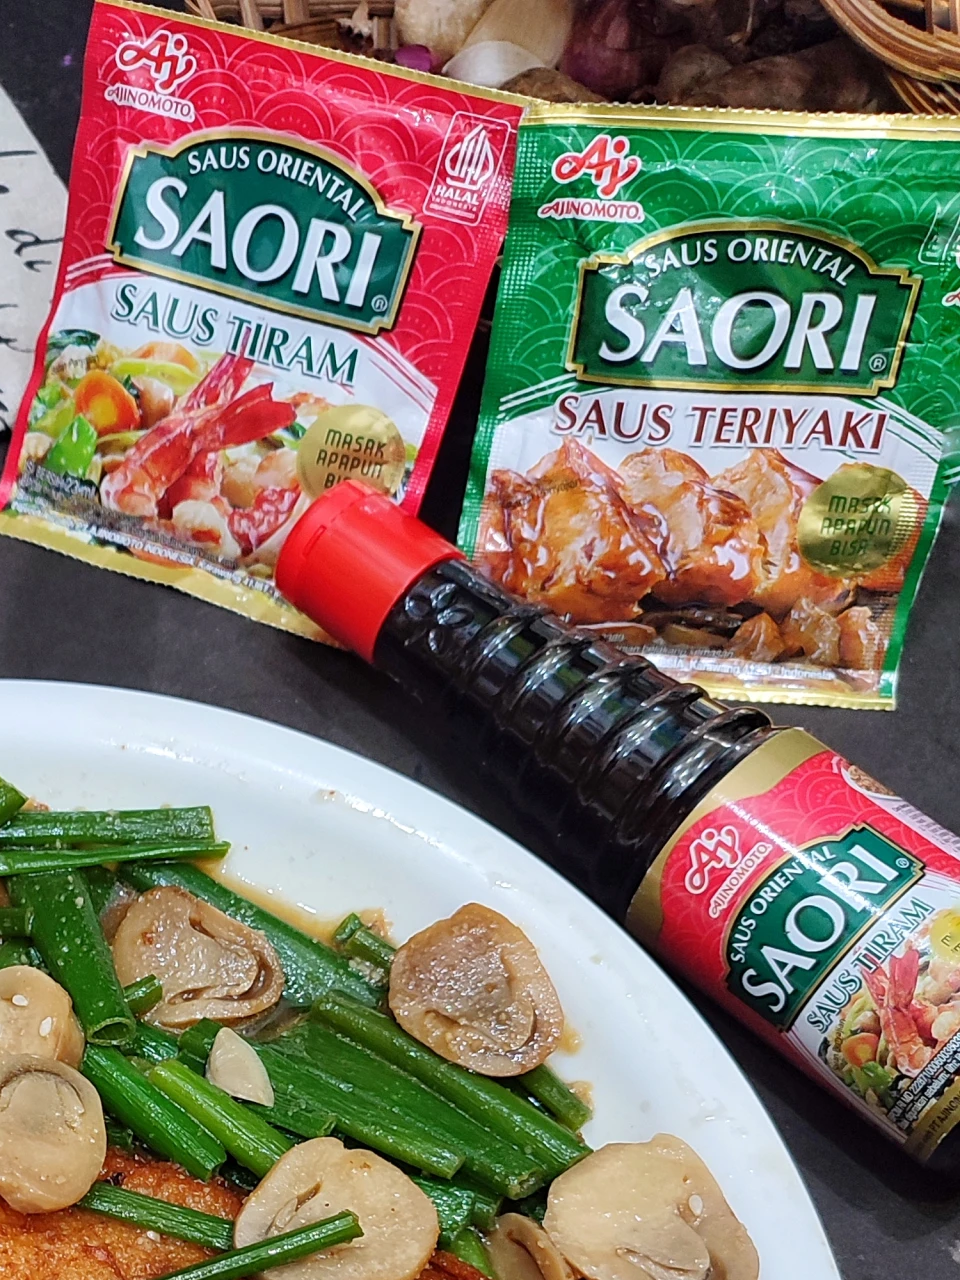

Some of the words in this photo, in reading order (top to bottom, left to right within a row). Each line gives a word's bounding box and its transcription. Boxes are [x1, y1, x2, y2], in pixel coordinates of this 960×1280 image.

[107, 86, 192, 117] AJINOMOTO
[187, 141, 251, 174] SAUS
[258, 149, 362, 221] ORIENTAL
[435, 185, 479, 205] HALAL
[541, 202, 641, 219] AJINOMOTO
[134, 177, 382, 308] SAORI
[646, 240, 718, 278] SAUS
[727, 239, 856, 286] ORIENTAL
[113, 282, 218, 343] SAUS
[232, 316, 360, 388] TIRAM
[597, 284, 876, 371] SAORI
[325, 429, 386, 459] MASAK
[554, 395, 674, 443] SAUS
[690, 406, 888, 450] TERIYAKI
[316, 449, 383, 479] APAPUN
[821, 518, 891, 535] APAPUN
[828, 496, 893, 514] MASAK
[830, 540, 868, 556] BISA
[711, 844, 770, 916] AJINOMOTO
[730, 916, 757, 963] SAUS
[750, 845, 837, 915] ORIENTAL
[742, 845, 899, 1013] SAORI
[806, 970, 861, 1034] SAUS
[853, 898, 935, 972] TIRAM
